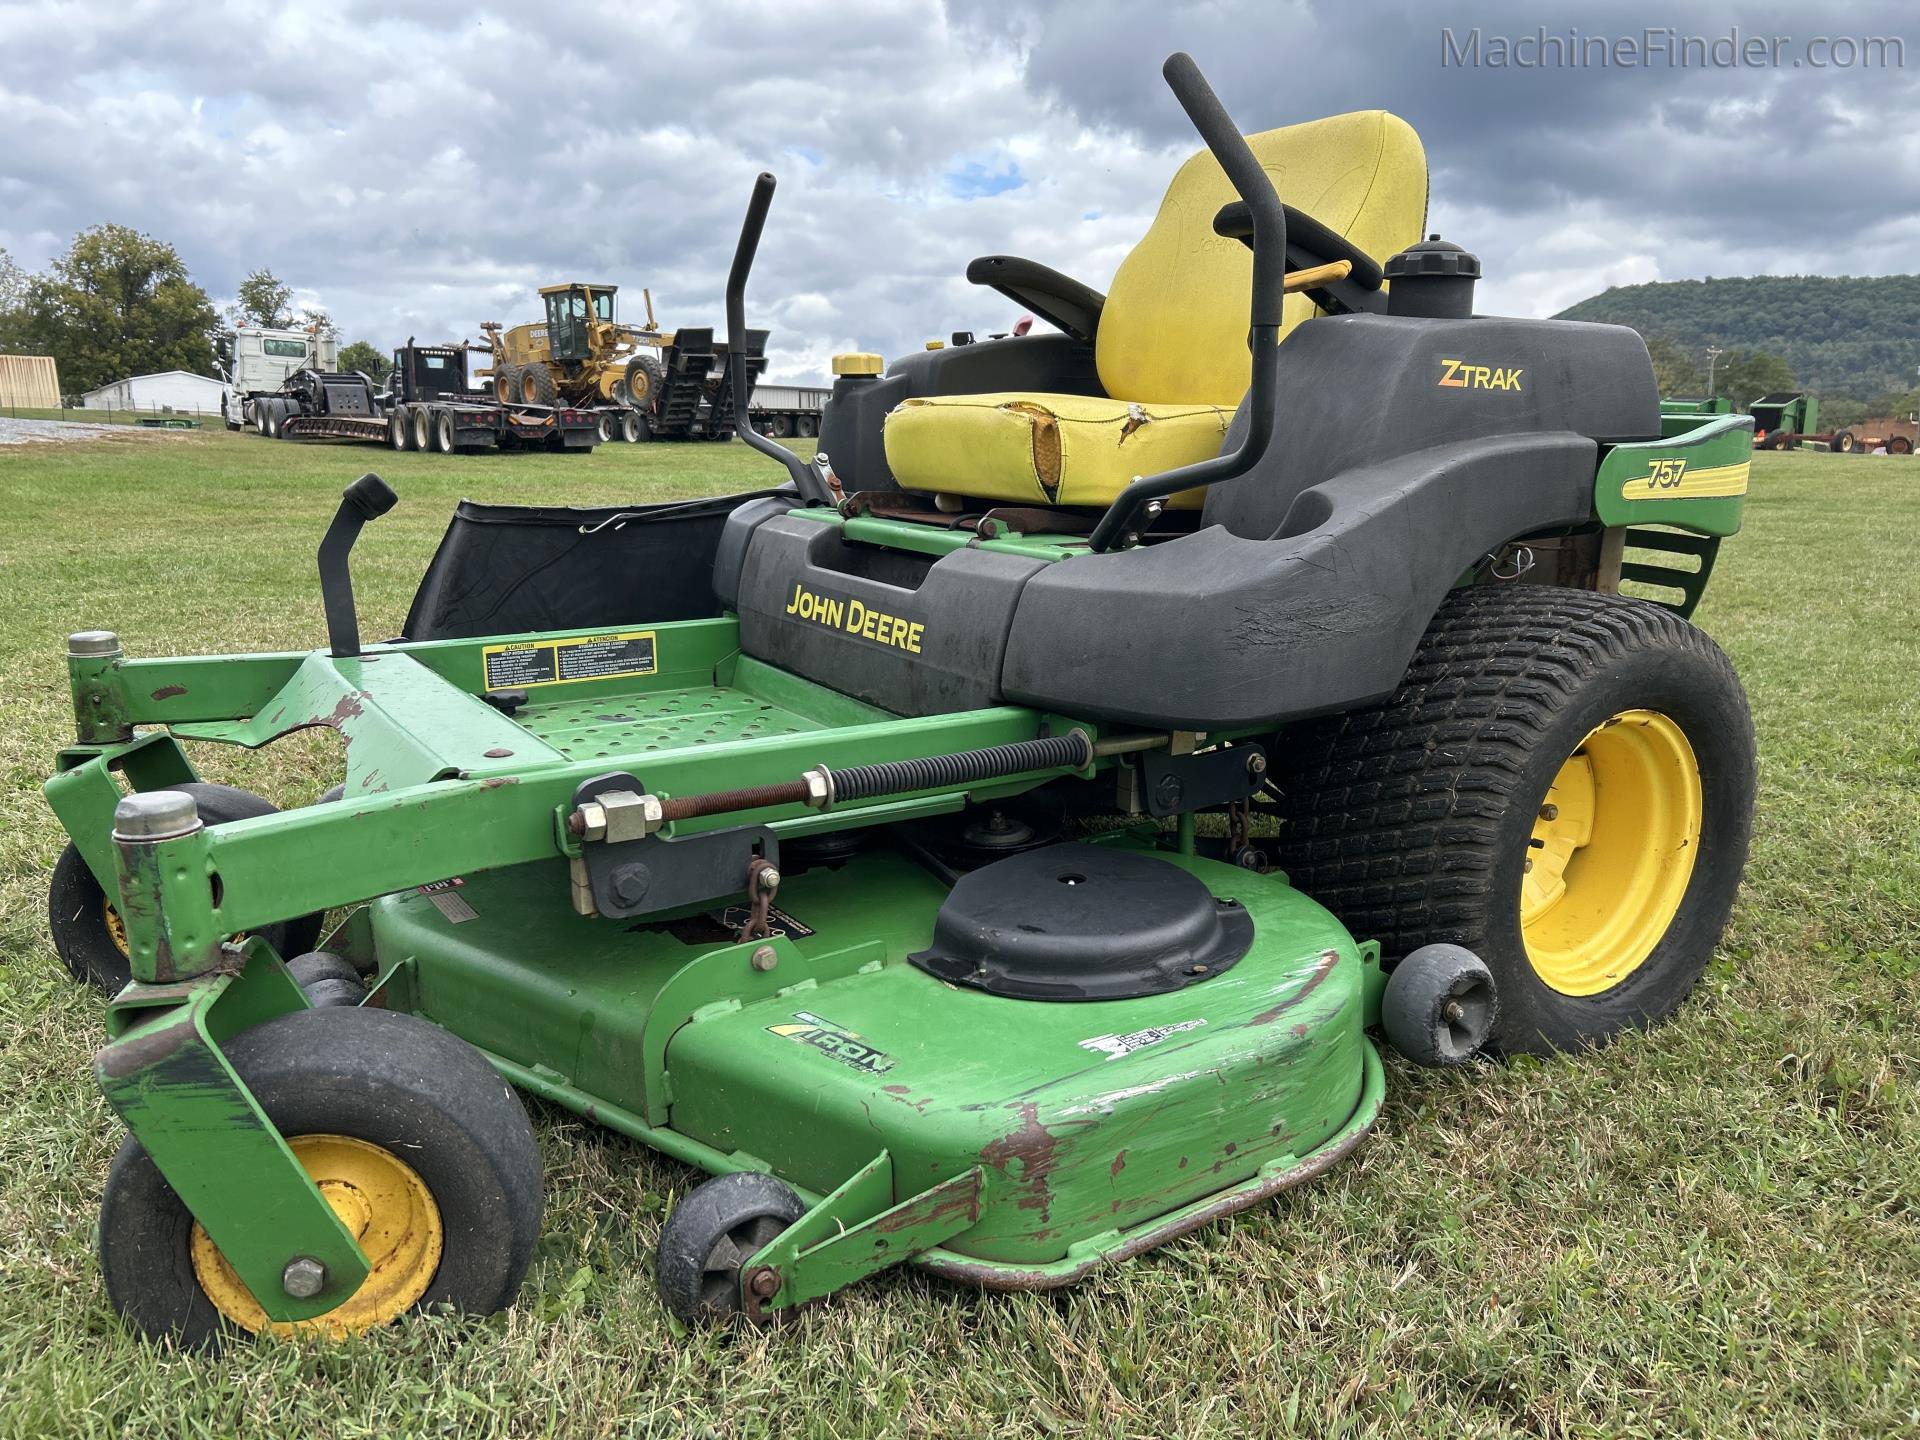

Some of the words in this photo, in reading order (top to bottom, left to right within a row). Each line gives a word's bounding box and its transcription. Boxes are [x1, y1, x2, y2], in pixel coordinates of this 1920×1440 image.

[1648, 458, 1688, 489] 757
[786, 584, 844, 629] JOHN
[846, 599, 925, 654] DEERE
[510, 643, 535, 651] CAUTION
